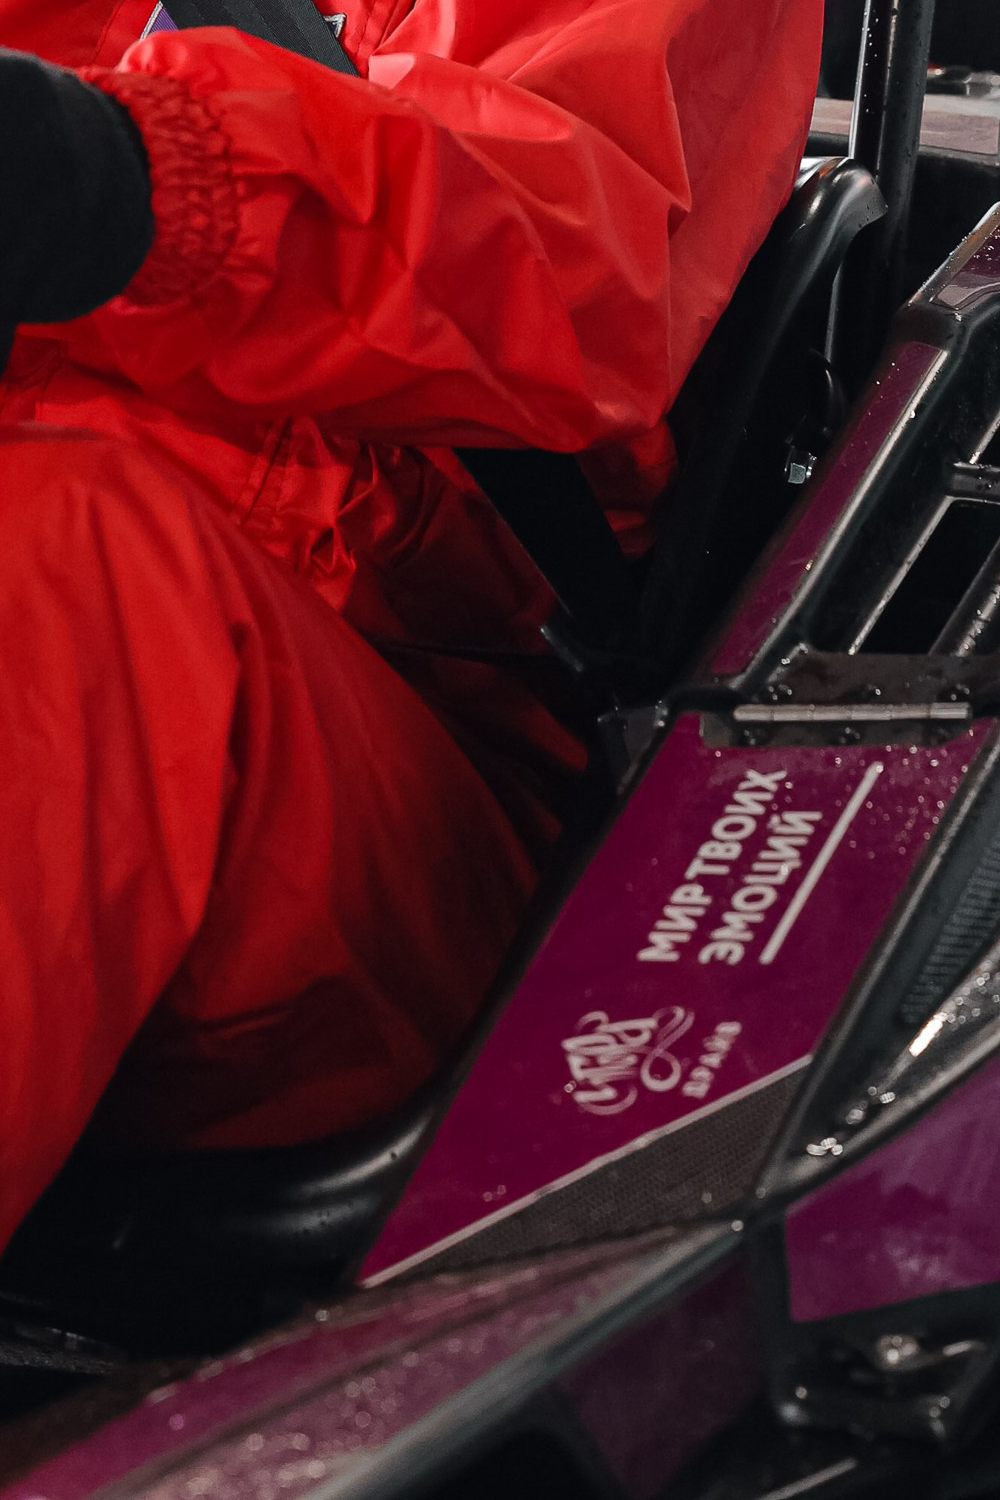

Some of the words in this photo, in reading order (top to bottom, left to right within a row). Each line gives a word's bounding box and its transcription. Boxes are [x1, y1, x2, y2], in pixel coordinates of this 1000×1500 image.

[637, 884, 711, 962] МИР
[686, 769, 787, 880] ТВОИХ
[698, 811, 823, 965] ЭМОЦИЙ
